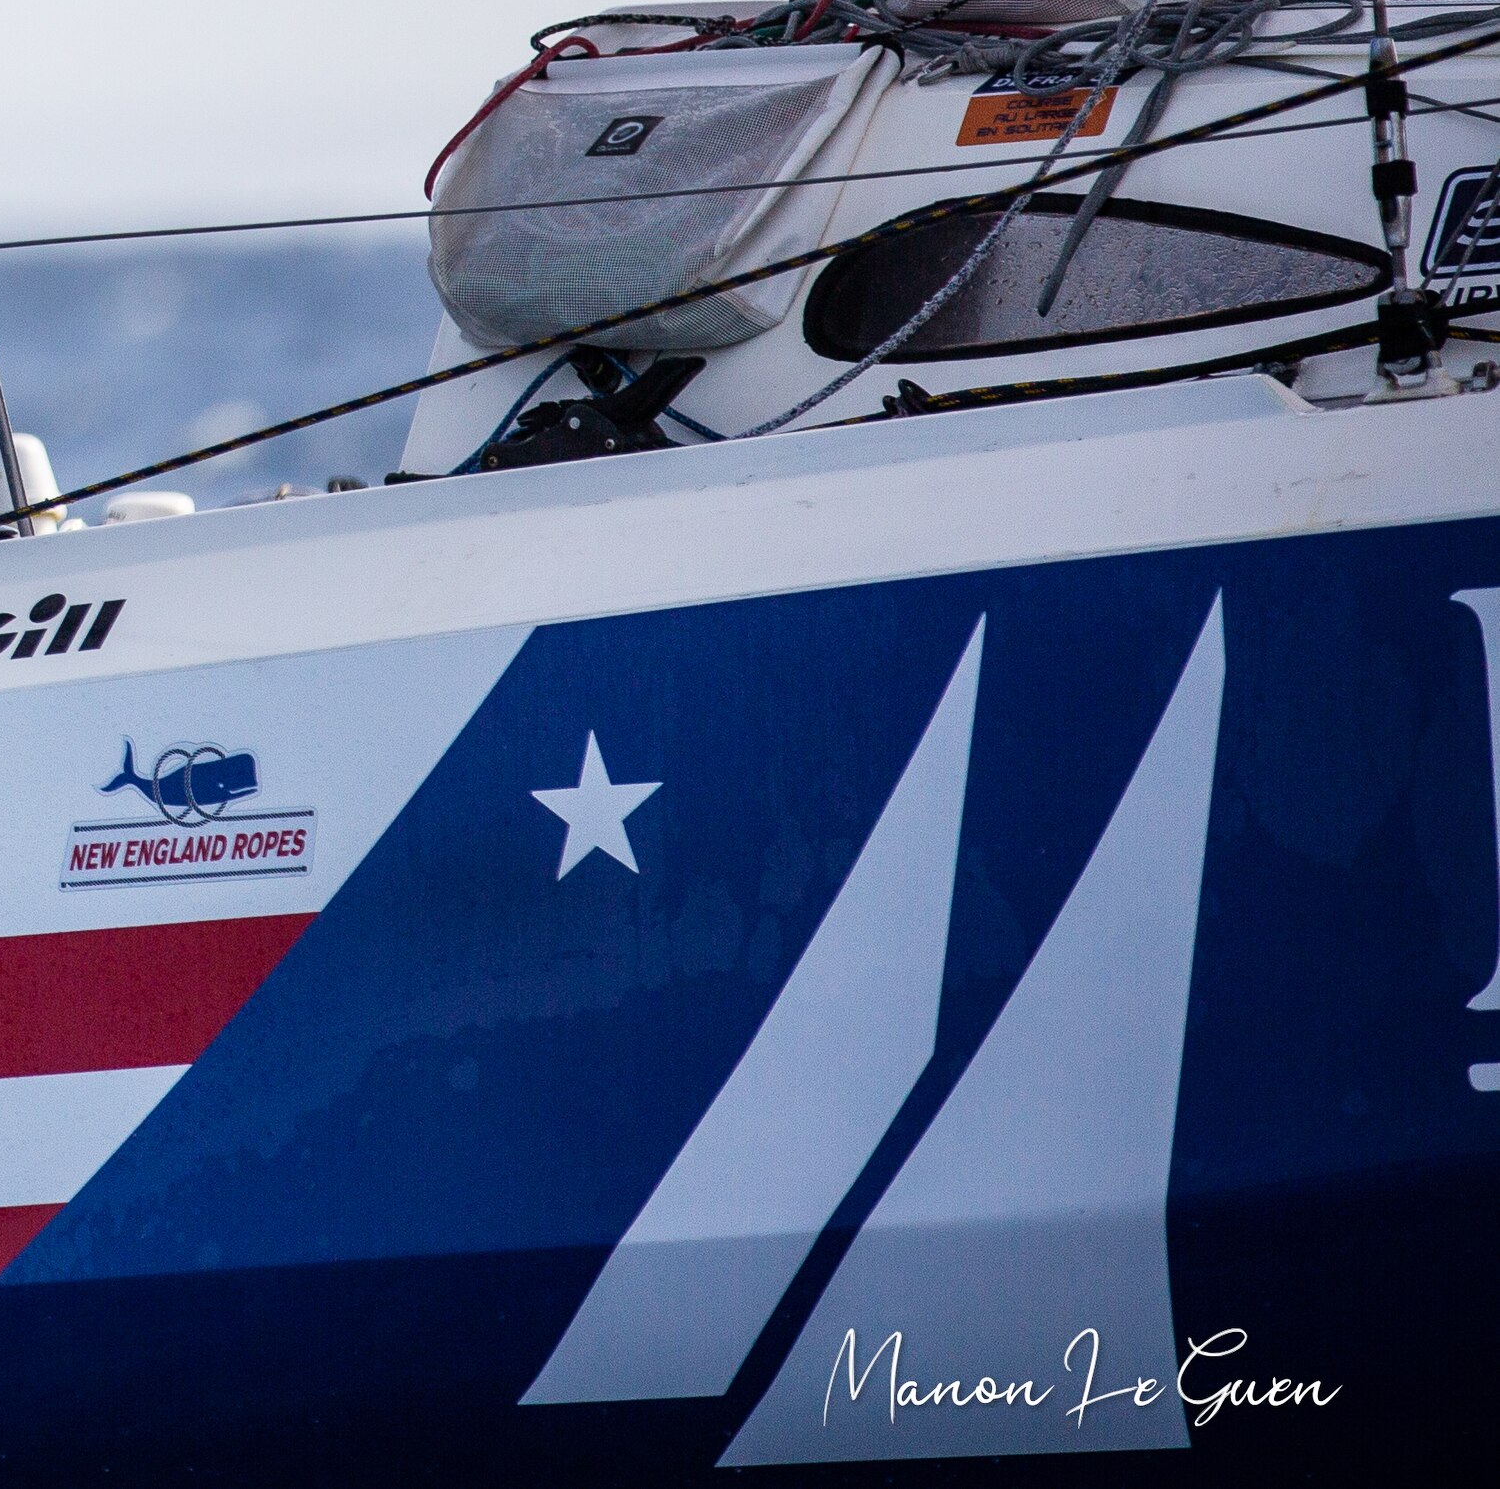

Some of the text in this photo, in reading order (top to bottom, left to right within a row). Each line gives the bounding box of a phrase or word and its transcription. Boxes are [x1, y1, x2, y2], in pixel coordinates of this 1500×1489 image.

[69, 829, 308, 871] NEW ENGLAND ROPES
